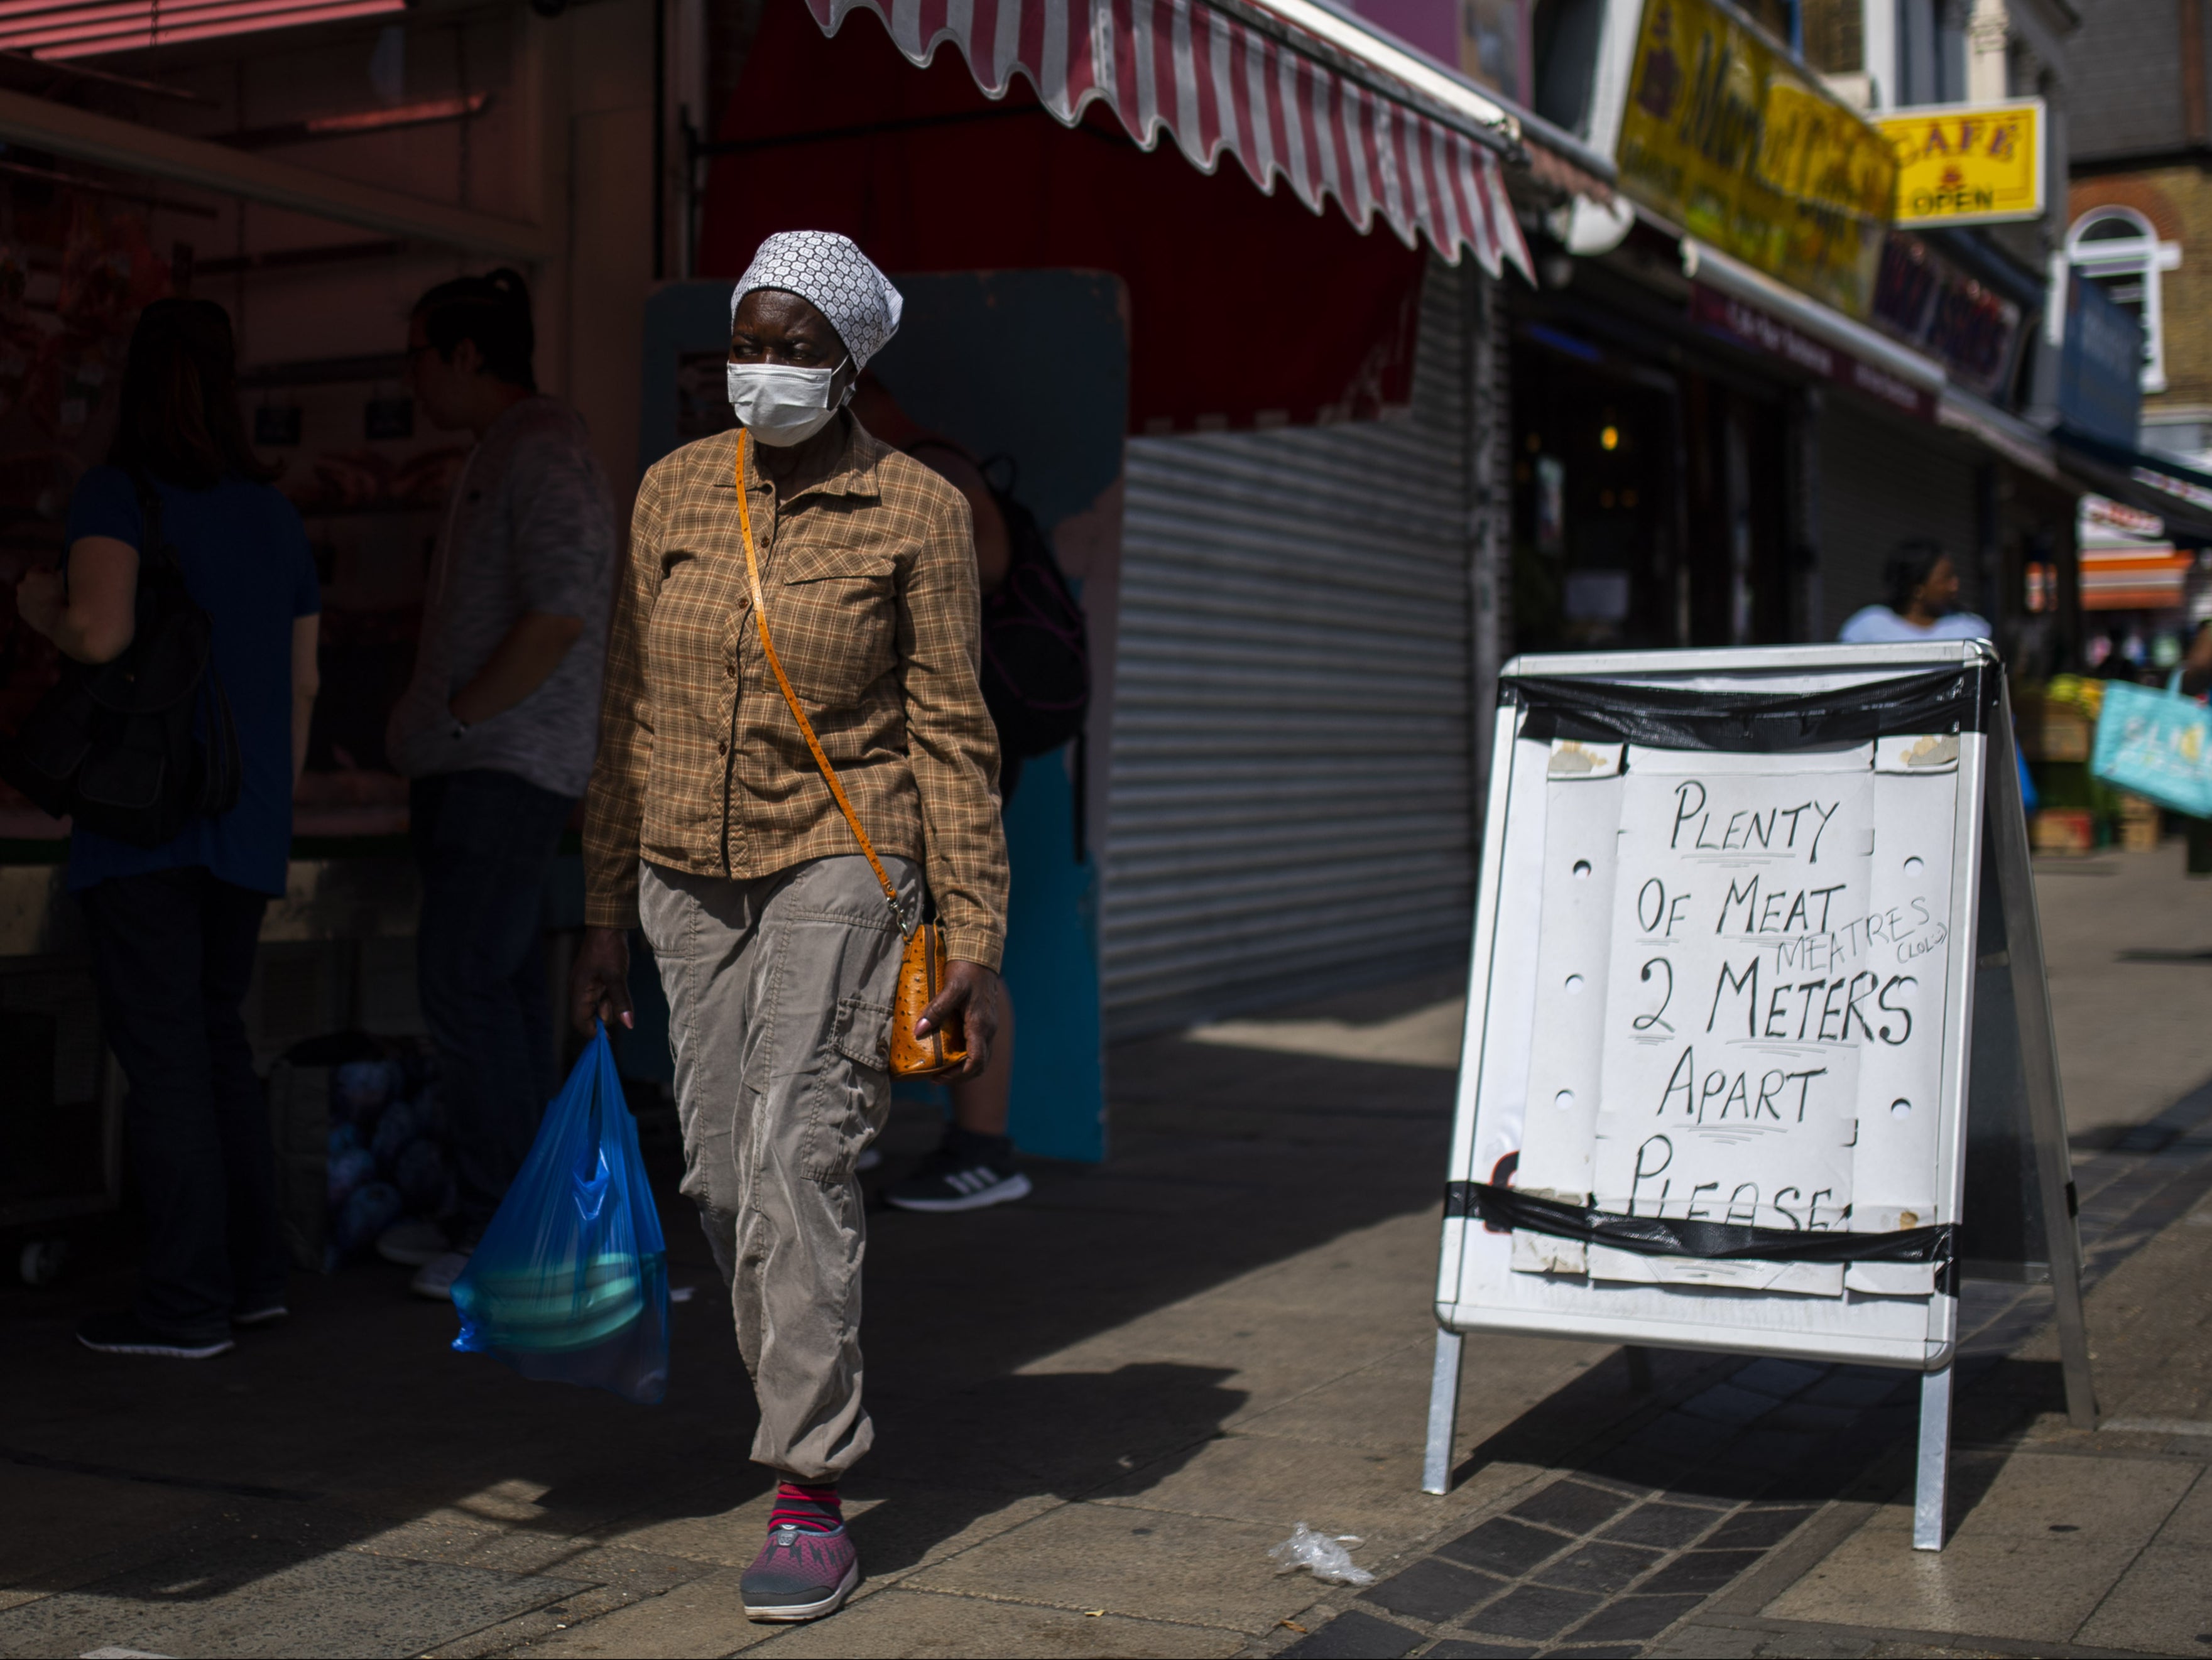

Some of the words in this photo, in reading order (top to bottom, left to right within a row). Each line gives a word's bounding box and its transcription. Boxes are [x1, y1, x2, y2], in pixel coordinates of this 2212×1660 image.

[1912, 190, 1994, 215] OPEN
[1670, 779, 1840, 864] PLENTY
[1638, 877, 1691, 937] OF
[1715, 873, 1846, 935] MEAT
[1777, 896, 1930, 975] MEATRES
[1632, 957, 1675, 1033] 2
[1706, 955, 1912, 1045] METERS
[1656, 1045, 1829, 1125] APART
